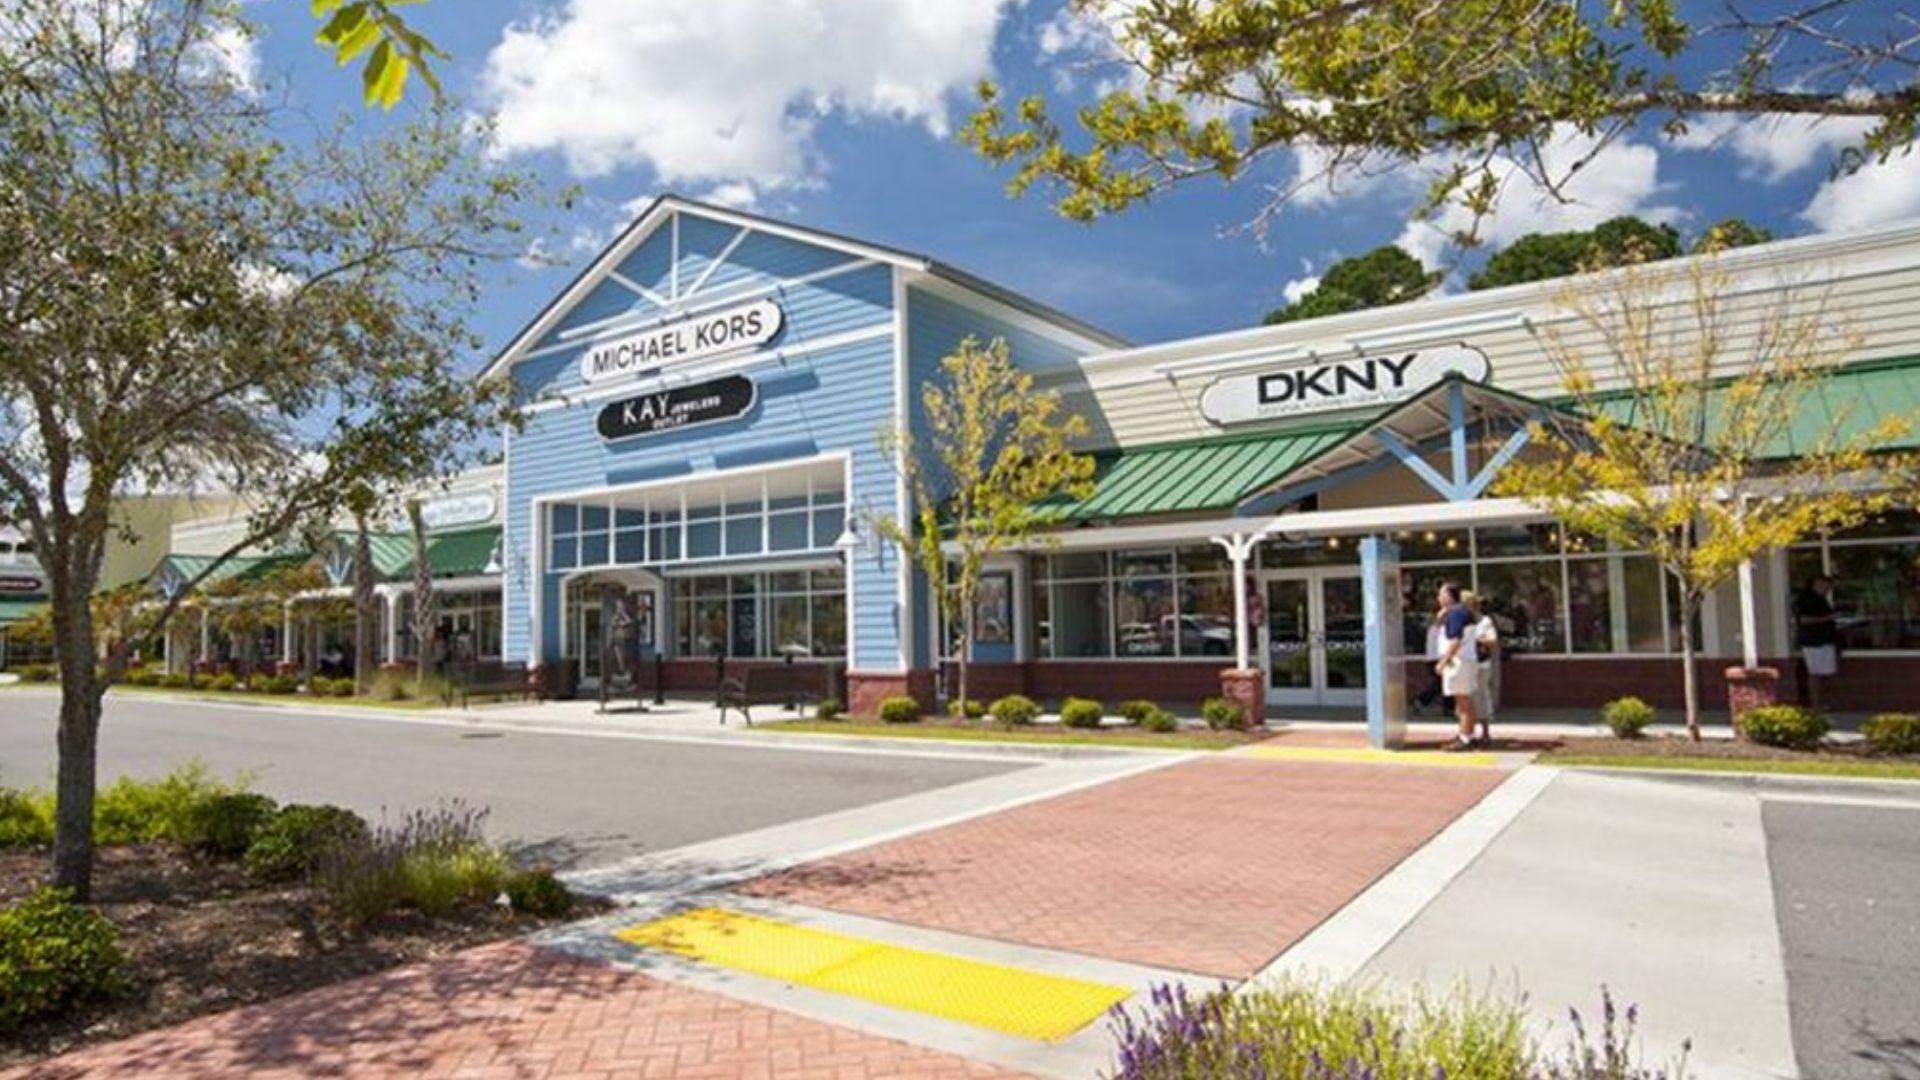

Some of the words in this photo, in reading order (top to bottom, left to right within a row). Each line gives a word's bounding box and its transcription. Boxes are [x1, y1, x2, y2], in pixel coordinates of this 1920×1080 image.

[593, 331, 686, 375] MICHAEL
[695, 310, 762, 349] KORS
[1257, 353, 1418, 405] DKNY
[624, 394, 671, 425] KAY
